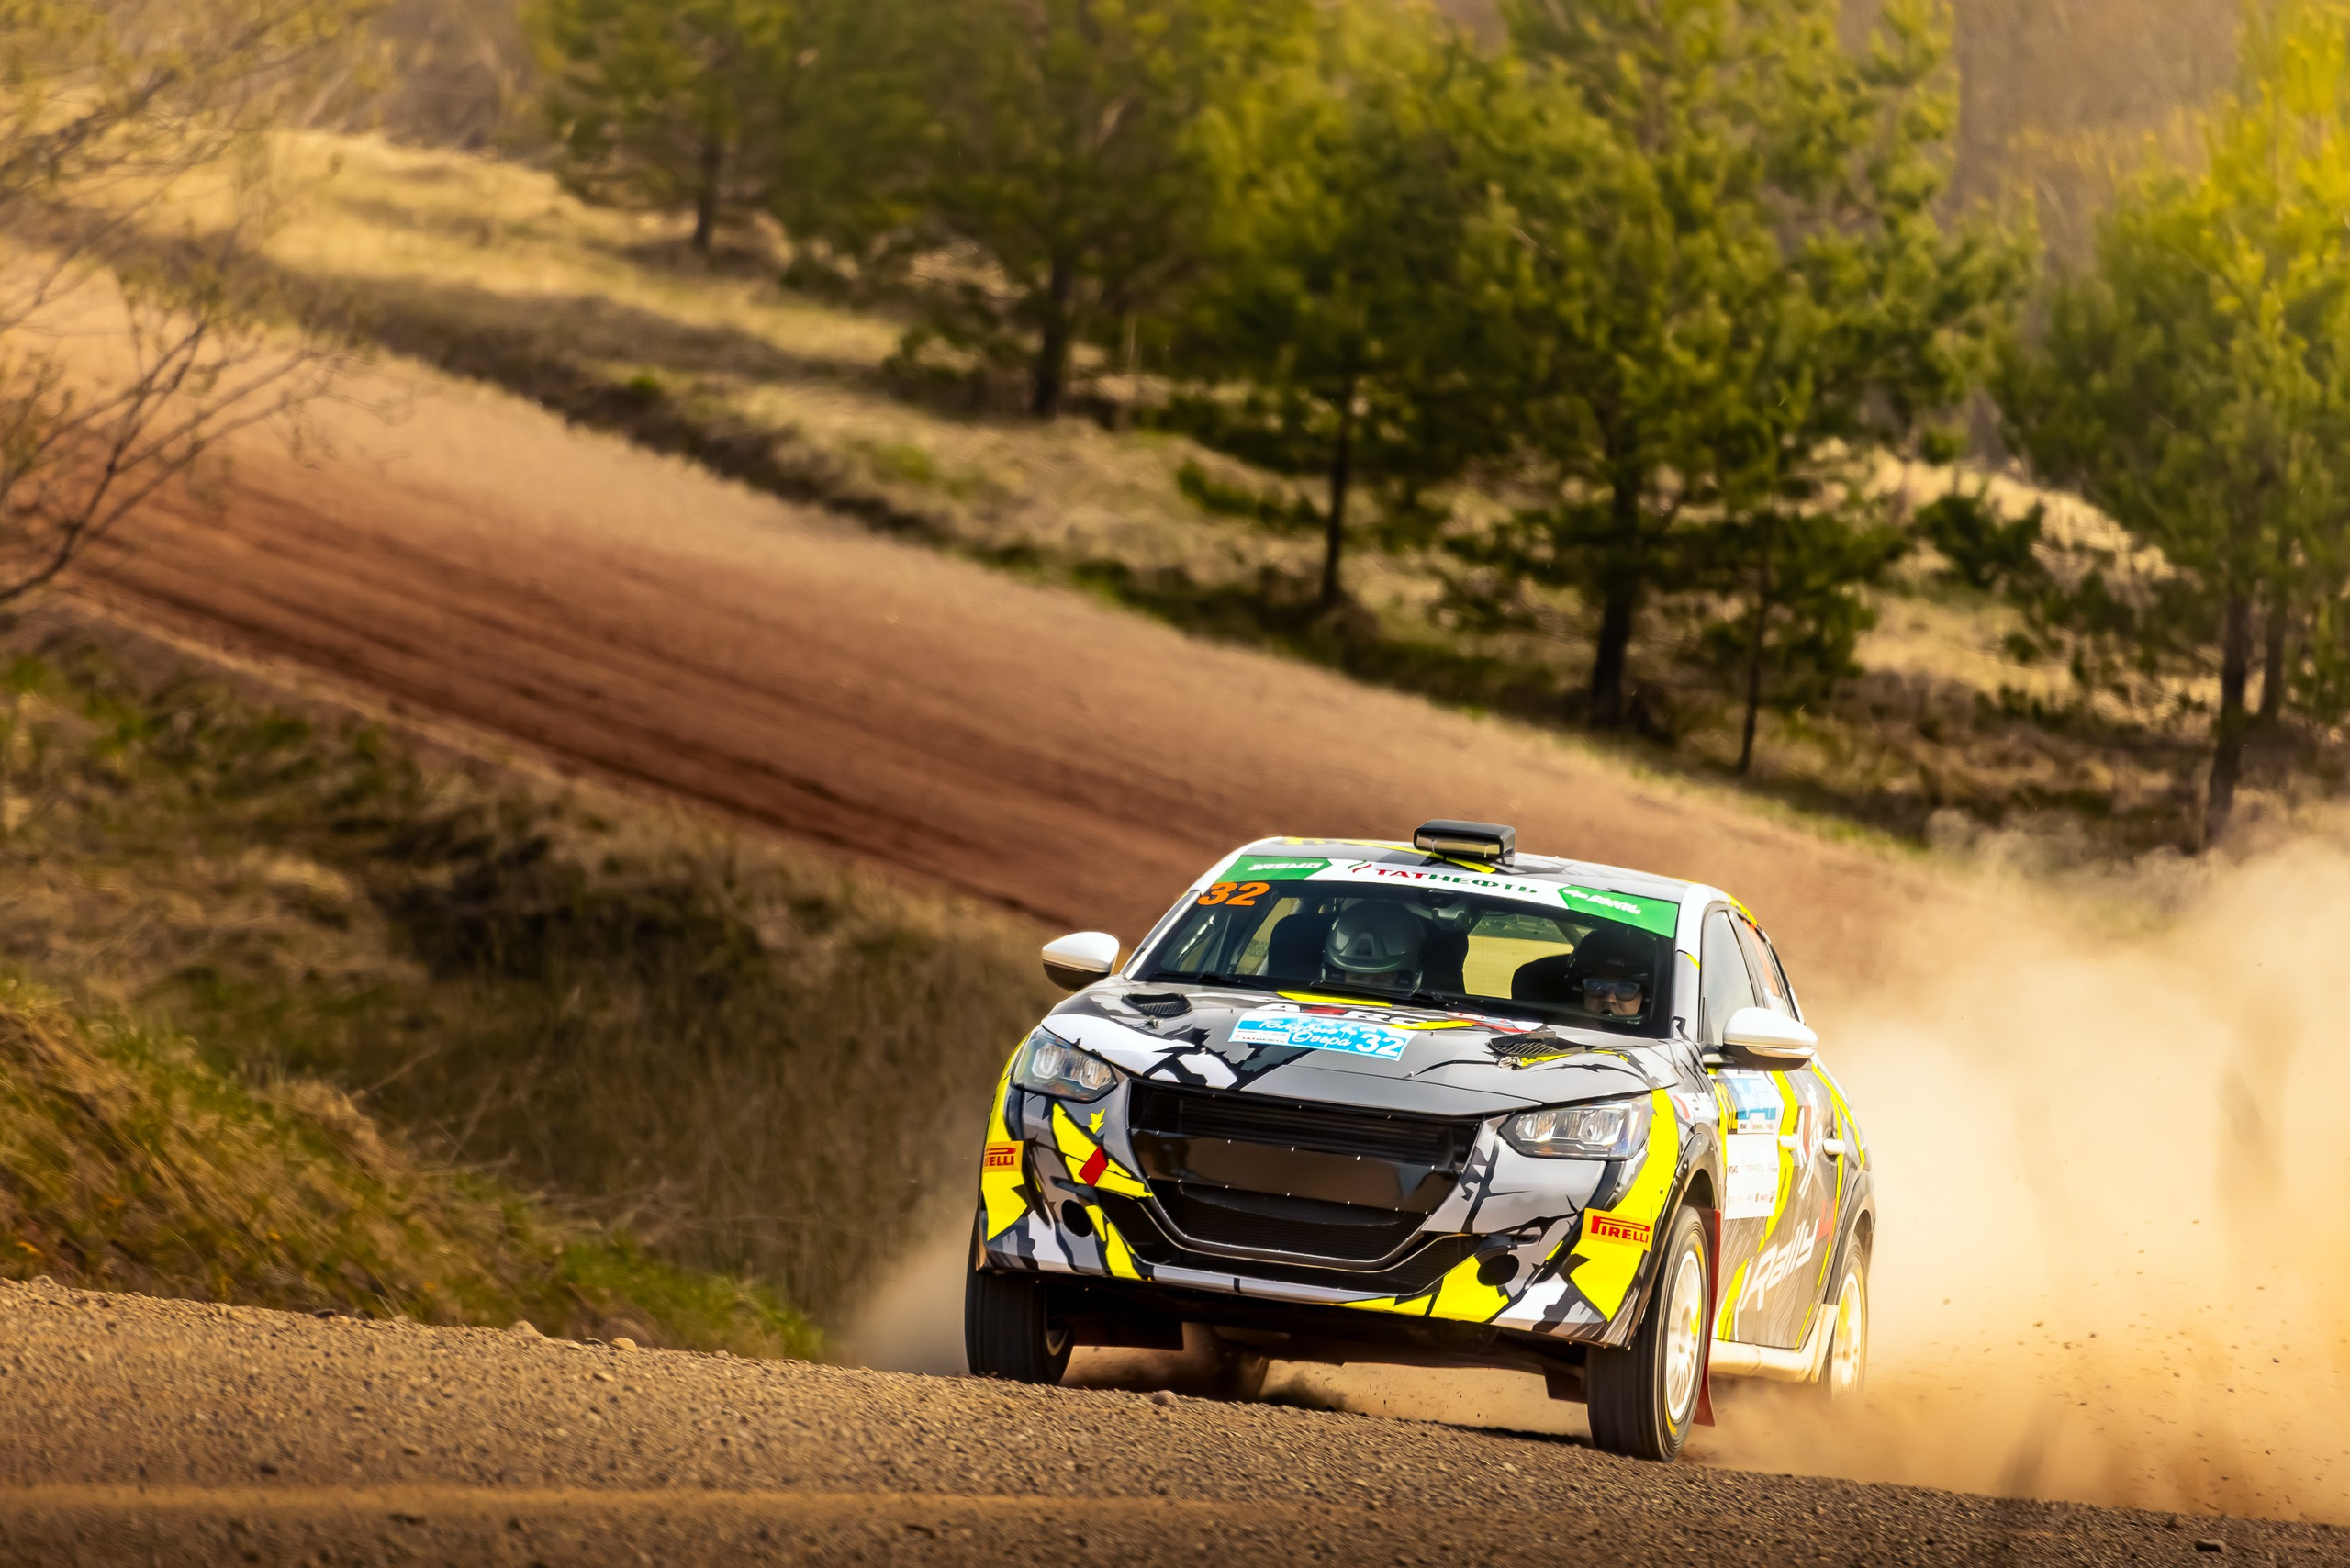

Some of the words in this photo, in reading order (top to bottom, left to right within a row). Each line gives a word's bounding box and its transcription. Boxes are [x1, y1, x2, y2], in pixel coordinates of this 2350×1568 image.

[1375, 868, 1538, 893] ТАТНЕФТЬ
[1197, 881, 1270, 906] 32
[1292, 1031, 1352, 1047] Озера
[1355, 1033, 1404, 1055] 32
[984, 1147, 1016, 1167] ELLI
[1591, 1215, 1650, 1243] PIRELLI
